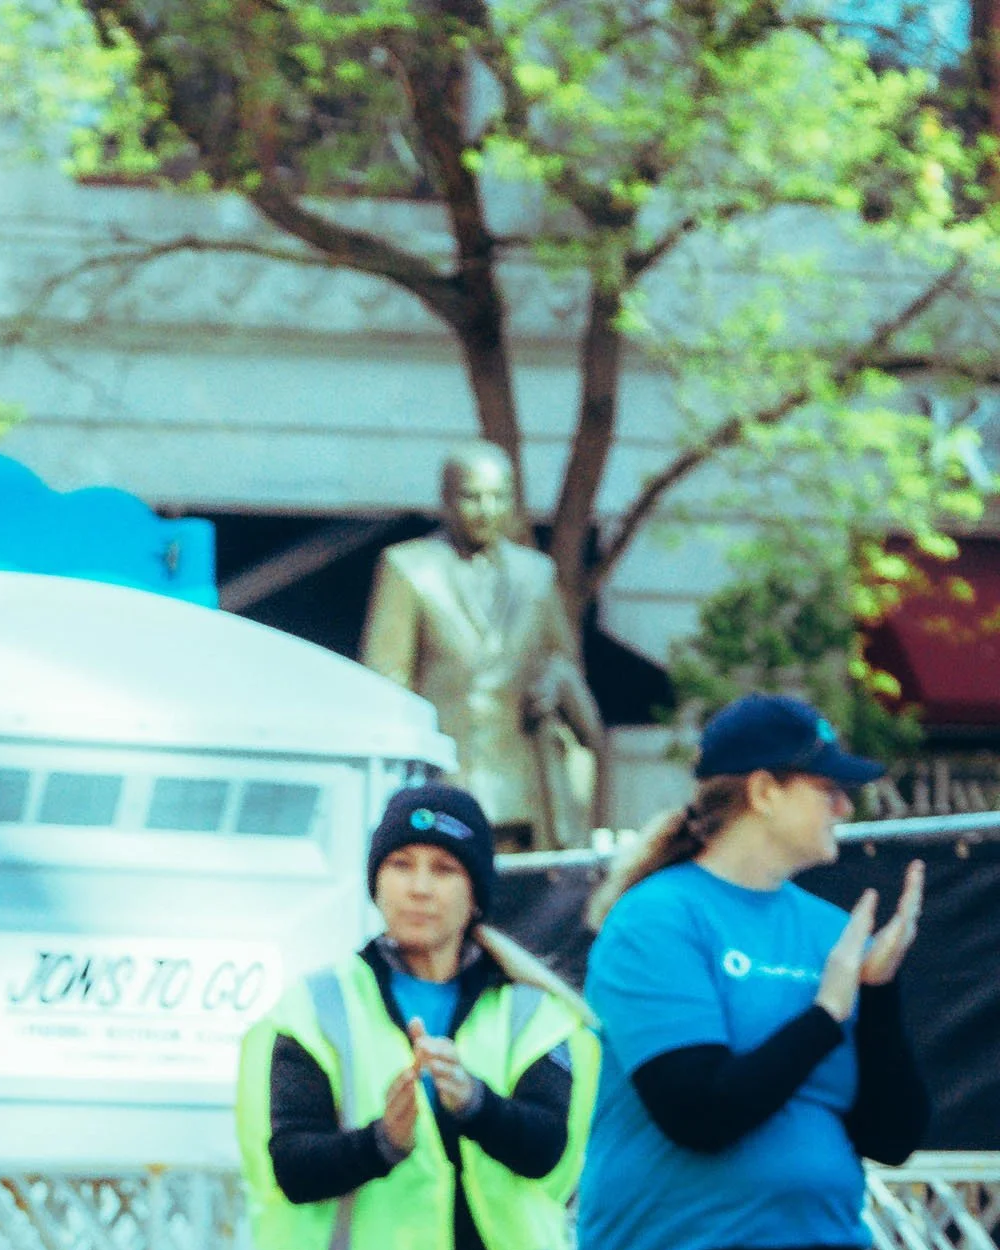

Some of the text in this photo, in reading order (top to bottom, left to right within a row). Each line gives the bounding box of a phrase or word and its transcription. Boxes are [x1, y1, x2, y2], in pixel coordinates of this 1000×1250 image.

[6, 949, 265, 1011] JONS TO GO
